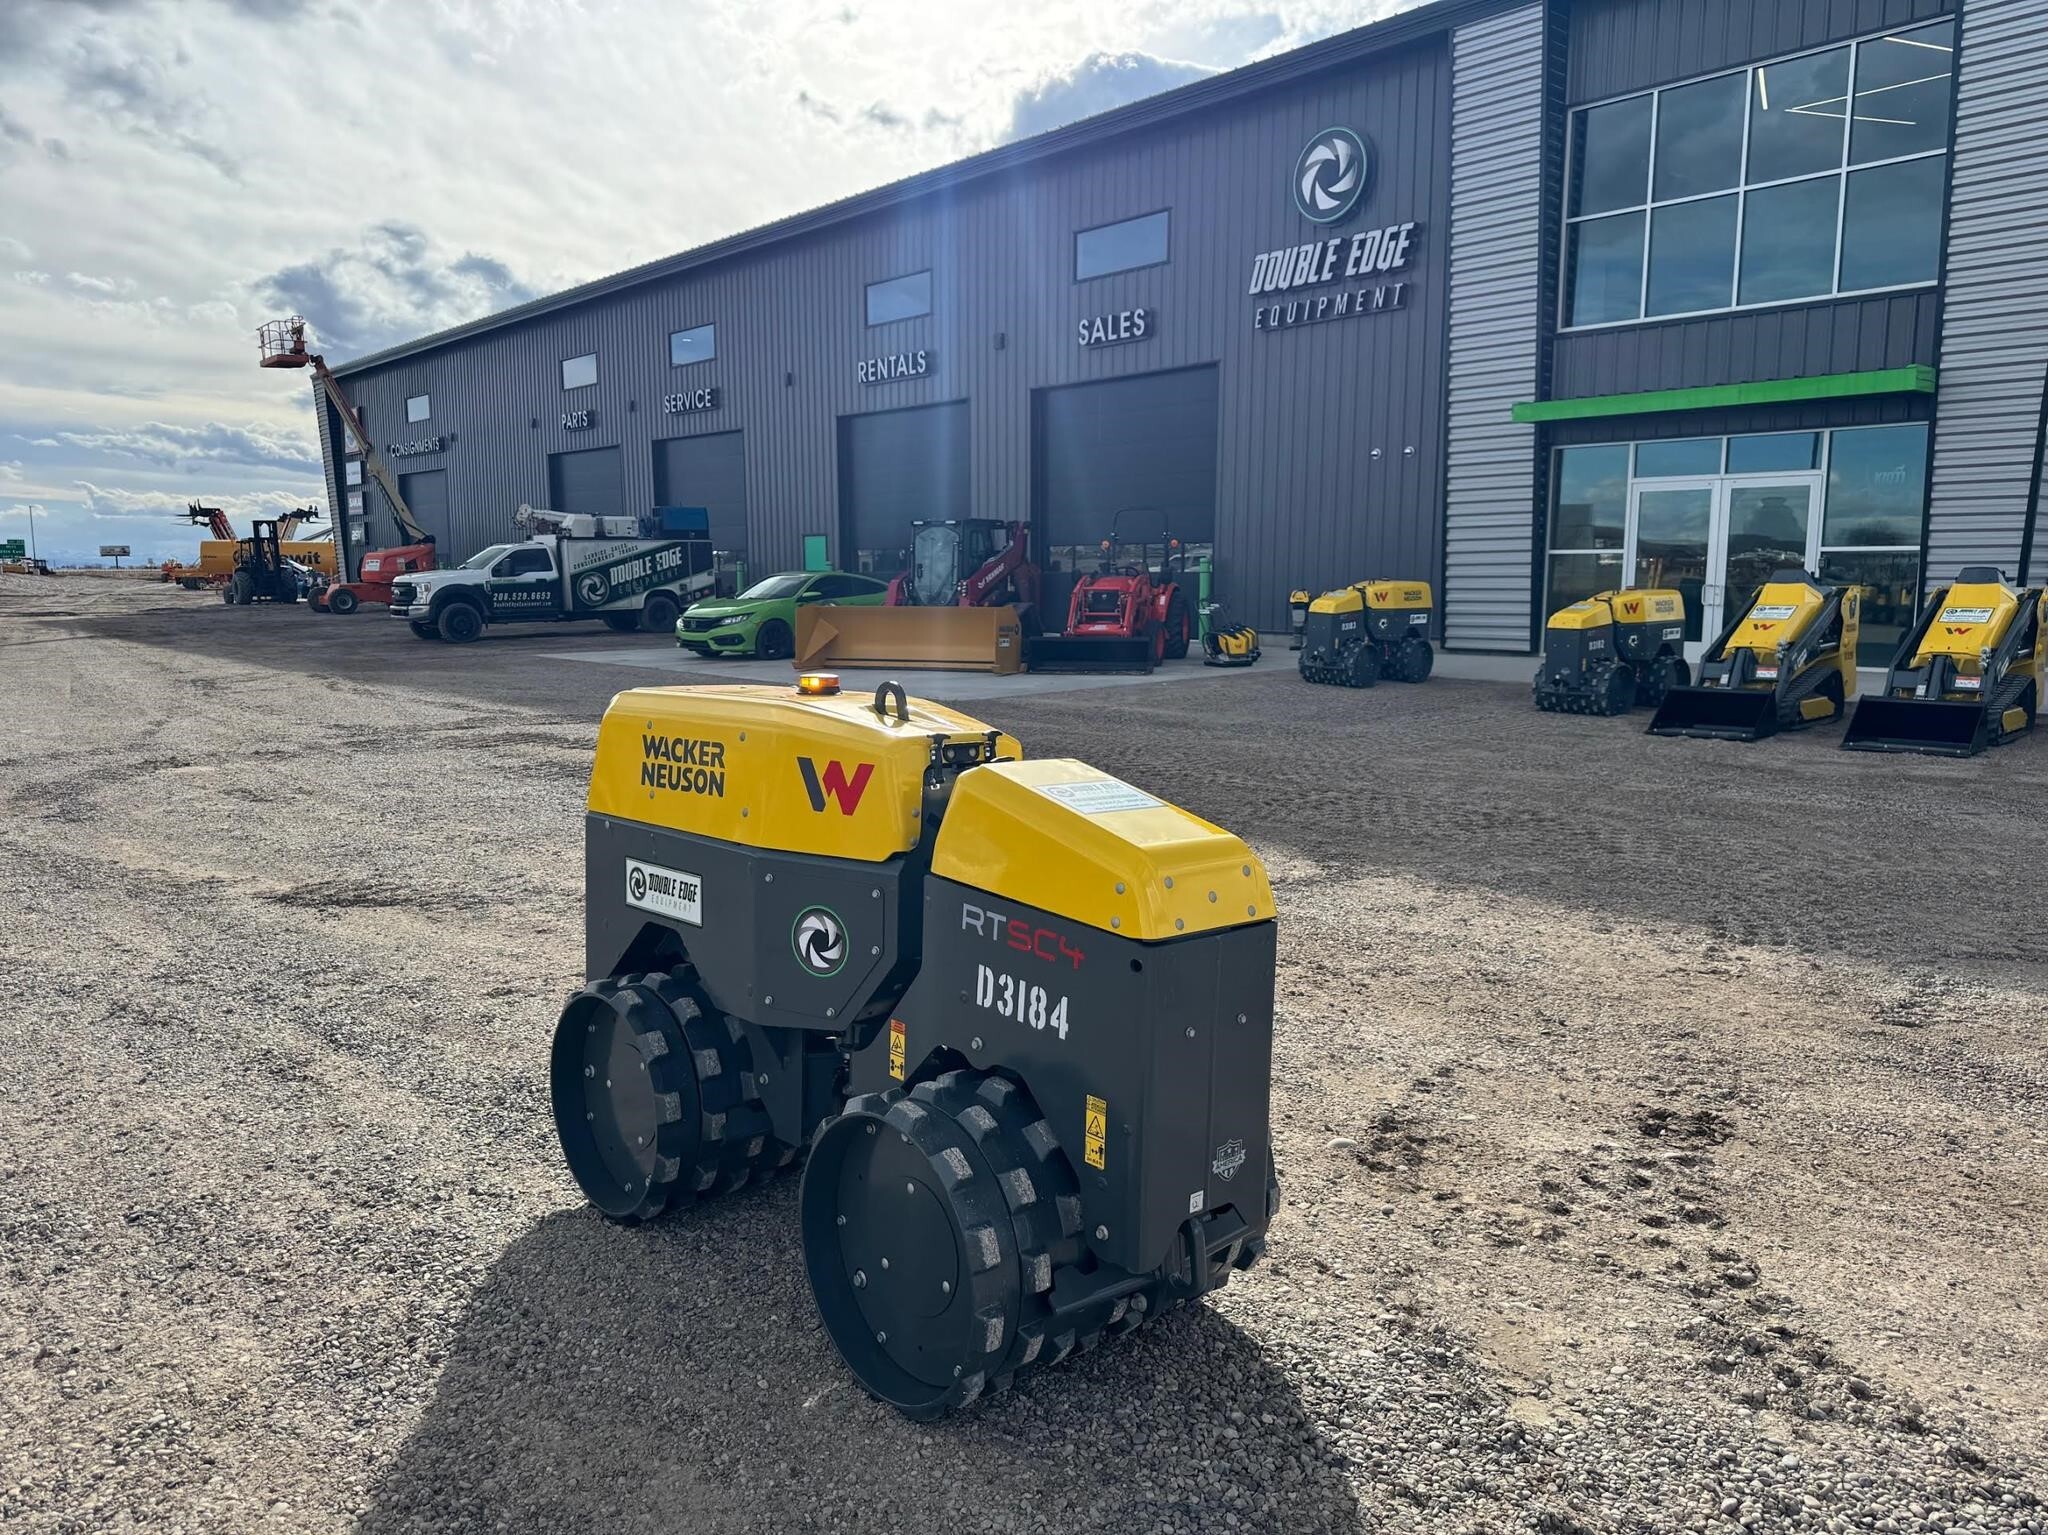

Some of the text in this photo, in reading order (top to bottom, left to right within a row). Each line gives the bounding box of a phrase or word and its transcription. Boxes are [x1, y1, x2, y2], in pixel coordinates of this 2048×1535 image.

[1248, 222, 1415, 295] DOUBLE EDGE
[1254, 283, 1404, 329] EQUIPMENT
[1078, 308, 1145, 346] SALES
[857, 350, 926, 383] RENTALS
[664, 388, 712, 414] SERVICE
[561, 410, 588, 430] PARTS
[390, 436, 440, 458] CONSIGNMENTS
[611, 542, 628, 553] SALES
[609, 546, 682, 586] DOUBLE EDGE
[641, 734, 726, 770] WACKER
[640, 762, 726, 798] NEUSON
[648, 873, 698, 903] DOUBLE EDGE
[650, 894, 692, 913] EQUIPMENT
[976, 963, 1069, 1041] D3184
